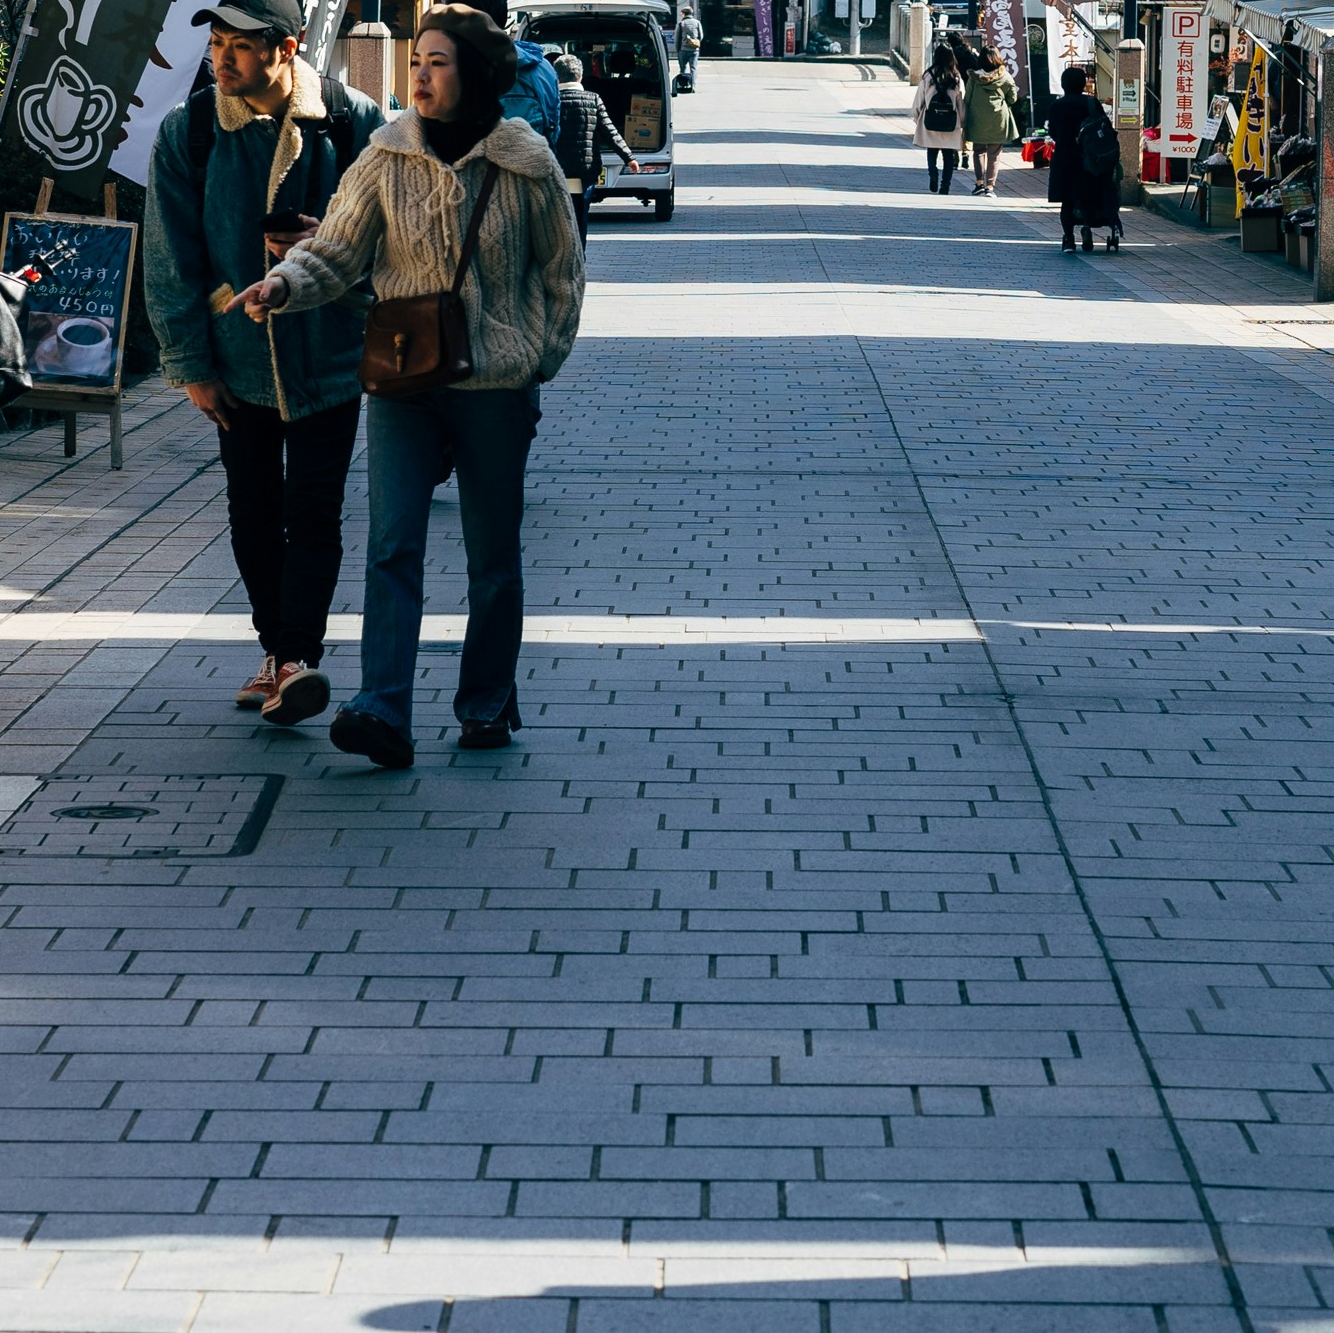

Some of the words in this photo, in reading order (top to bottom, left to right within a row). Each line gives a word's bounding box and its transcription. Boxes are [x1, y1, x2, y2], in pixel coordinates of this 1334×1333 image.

[1174, 40, 1195, 130] 有料駐車場
[59, 296, 115, 315] 450円
